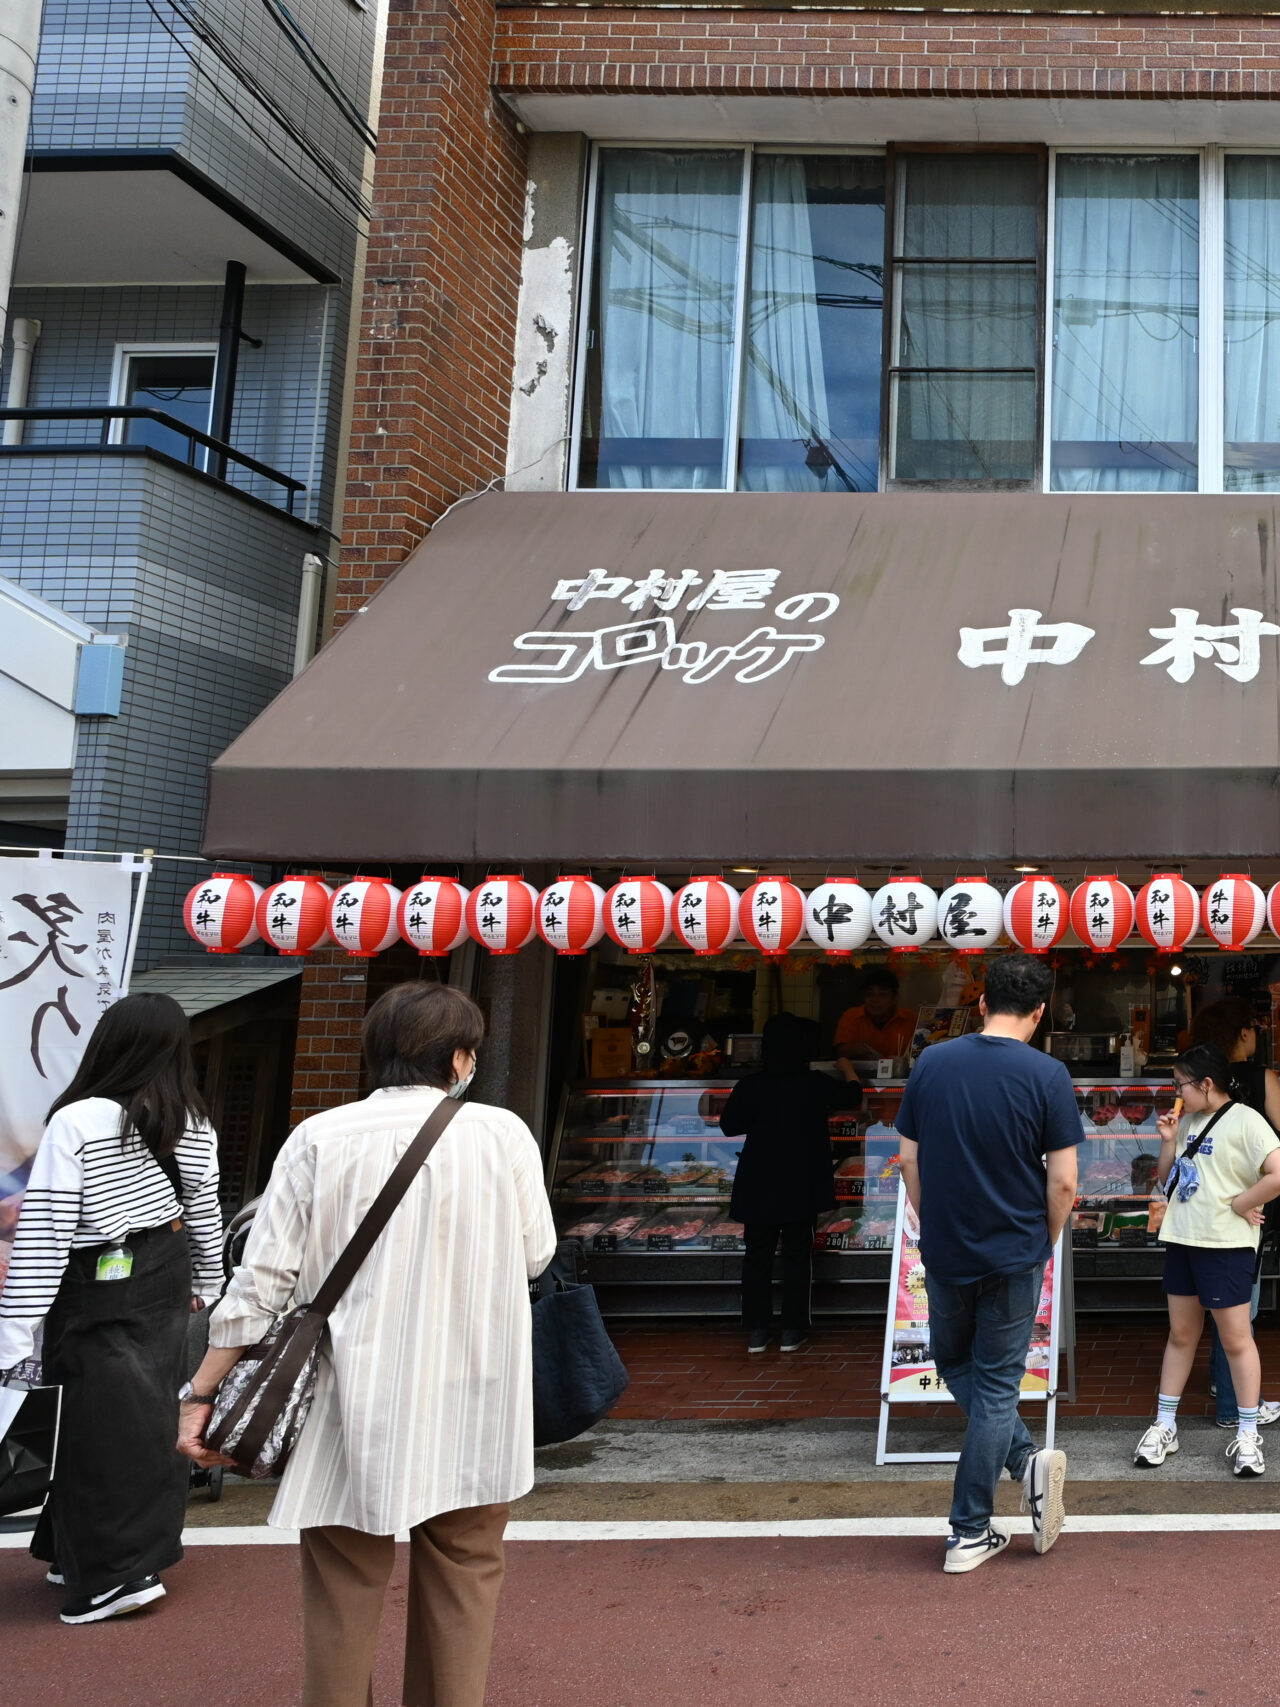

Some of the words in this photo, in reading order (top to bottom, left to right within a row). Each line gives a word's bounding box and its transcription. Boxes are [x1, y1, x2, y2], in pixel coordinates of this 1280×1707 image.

[550, 568, 841, 622] 中村屋の
[487, 616, 826, 686] コロッケ
[195, 888, 222, 930] 和牛
[271, 892, 296, 933] 和牛
[335, 892, 359, 932] 和牛
[408, 891, 432, 932] 和牛
[480, 892, 503, 932] 和牛
[544, 891, 566, 932] 和牛
[614, 892, 637, 932] 和牛
[681, 892, 702, 932] 和牛
[756, 892, 778, 932] 和牛
[812, 890, 989, 942] 中村屋
[1037, 893, 1057, 933] 和牛
[1089, 892, 1110, 932] 和牛
[1150, 888, 1170, 929] 和牛
[1210, 888, 1230, 929] 牛和
